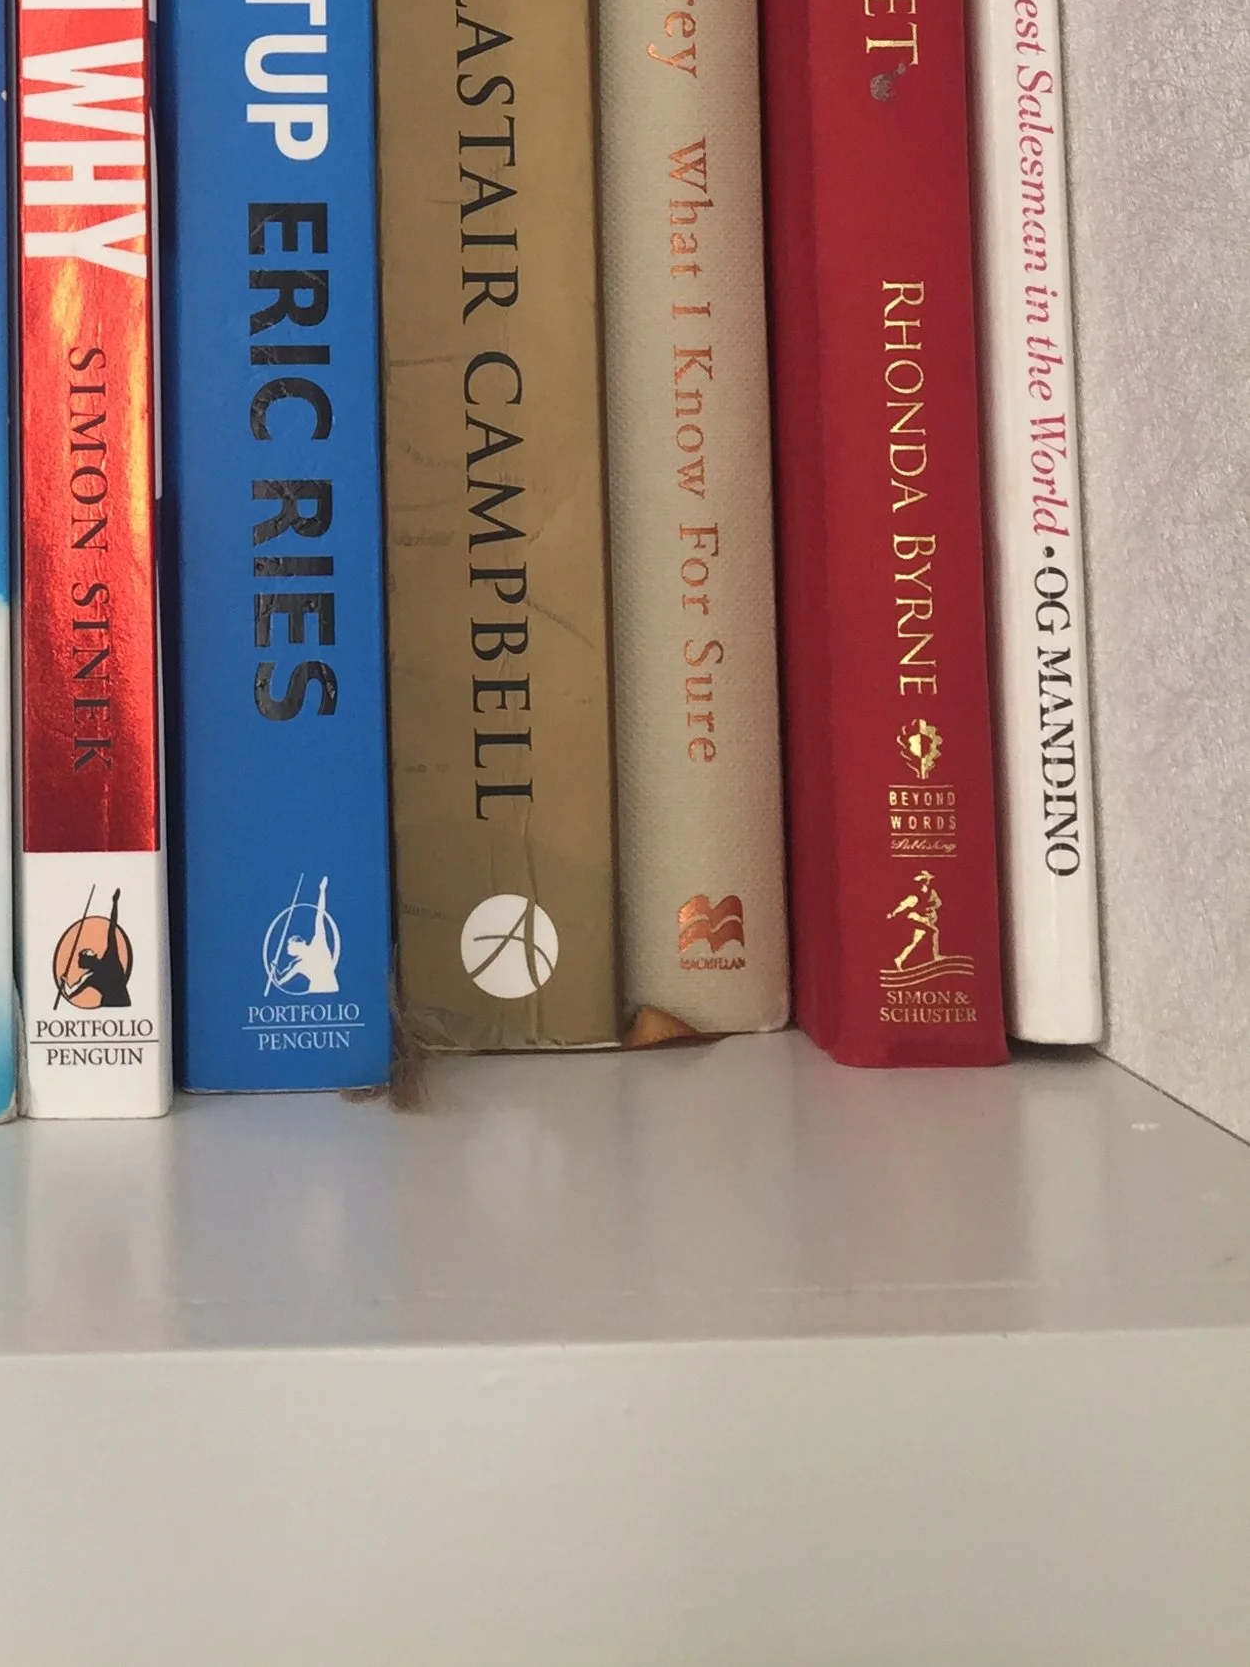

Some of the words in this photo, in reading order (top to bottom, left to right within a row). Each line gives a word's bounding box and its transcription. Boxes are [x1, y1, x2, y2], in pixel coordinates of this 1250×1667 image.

[20, 39, 148, 280] WHY
[1016, 64, 1054, 274] Salesman
[667, 136, 714, 278] What
[247, 201, 334, 442] ERIC
[671, 300, 712, 319] I
[1024, 284, 1059, 322] in
[881, 279, 930, 512] RHONDA
[1027, 331, 1065, 401] the
[67, 347, 108, 553] SIMON
[673, 343, 713, 499] Know
[1030, 412, 1070, 539] World
[250, 479, 338, 721] RIES
[463, 351, 534, 821] CAMPBELL
[679, 523, 720, 616] For
[893, 532, 937, 697] BYRNE
[1033, 564, 1072, 636] OG
[70, 581, 113, 774] SINEK
[684, 640, 724, 764] Sure
[889, 791, 955, 806] BEYOND
[1037, 646, 1082, 877] MANDINO
[891, 816, 957, 830] WORDS
[891, 838, 957, 854] Publishing
[678, 957, 746, 971] MACMILLAN
[886, 990, 951, 1005] SIMON
[954, 990, 970, 1005] &
[36, 1018, 153, 1038] PORTFOLIO
[46, 1046, 144, 1067] PENGUIN
[247, 1003, 360, 1024] PORTFOLIO
[258, 1030, 350, 1051] PENGUIN
[879, 1007, 978, 1024] SCHUSTER
